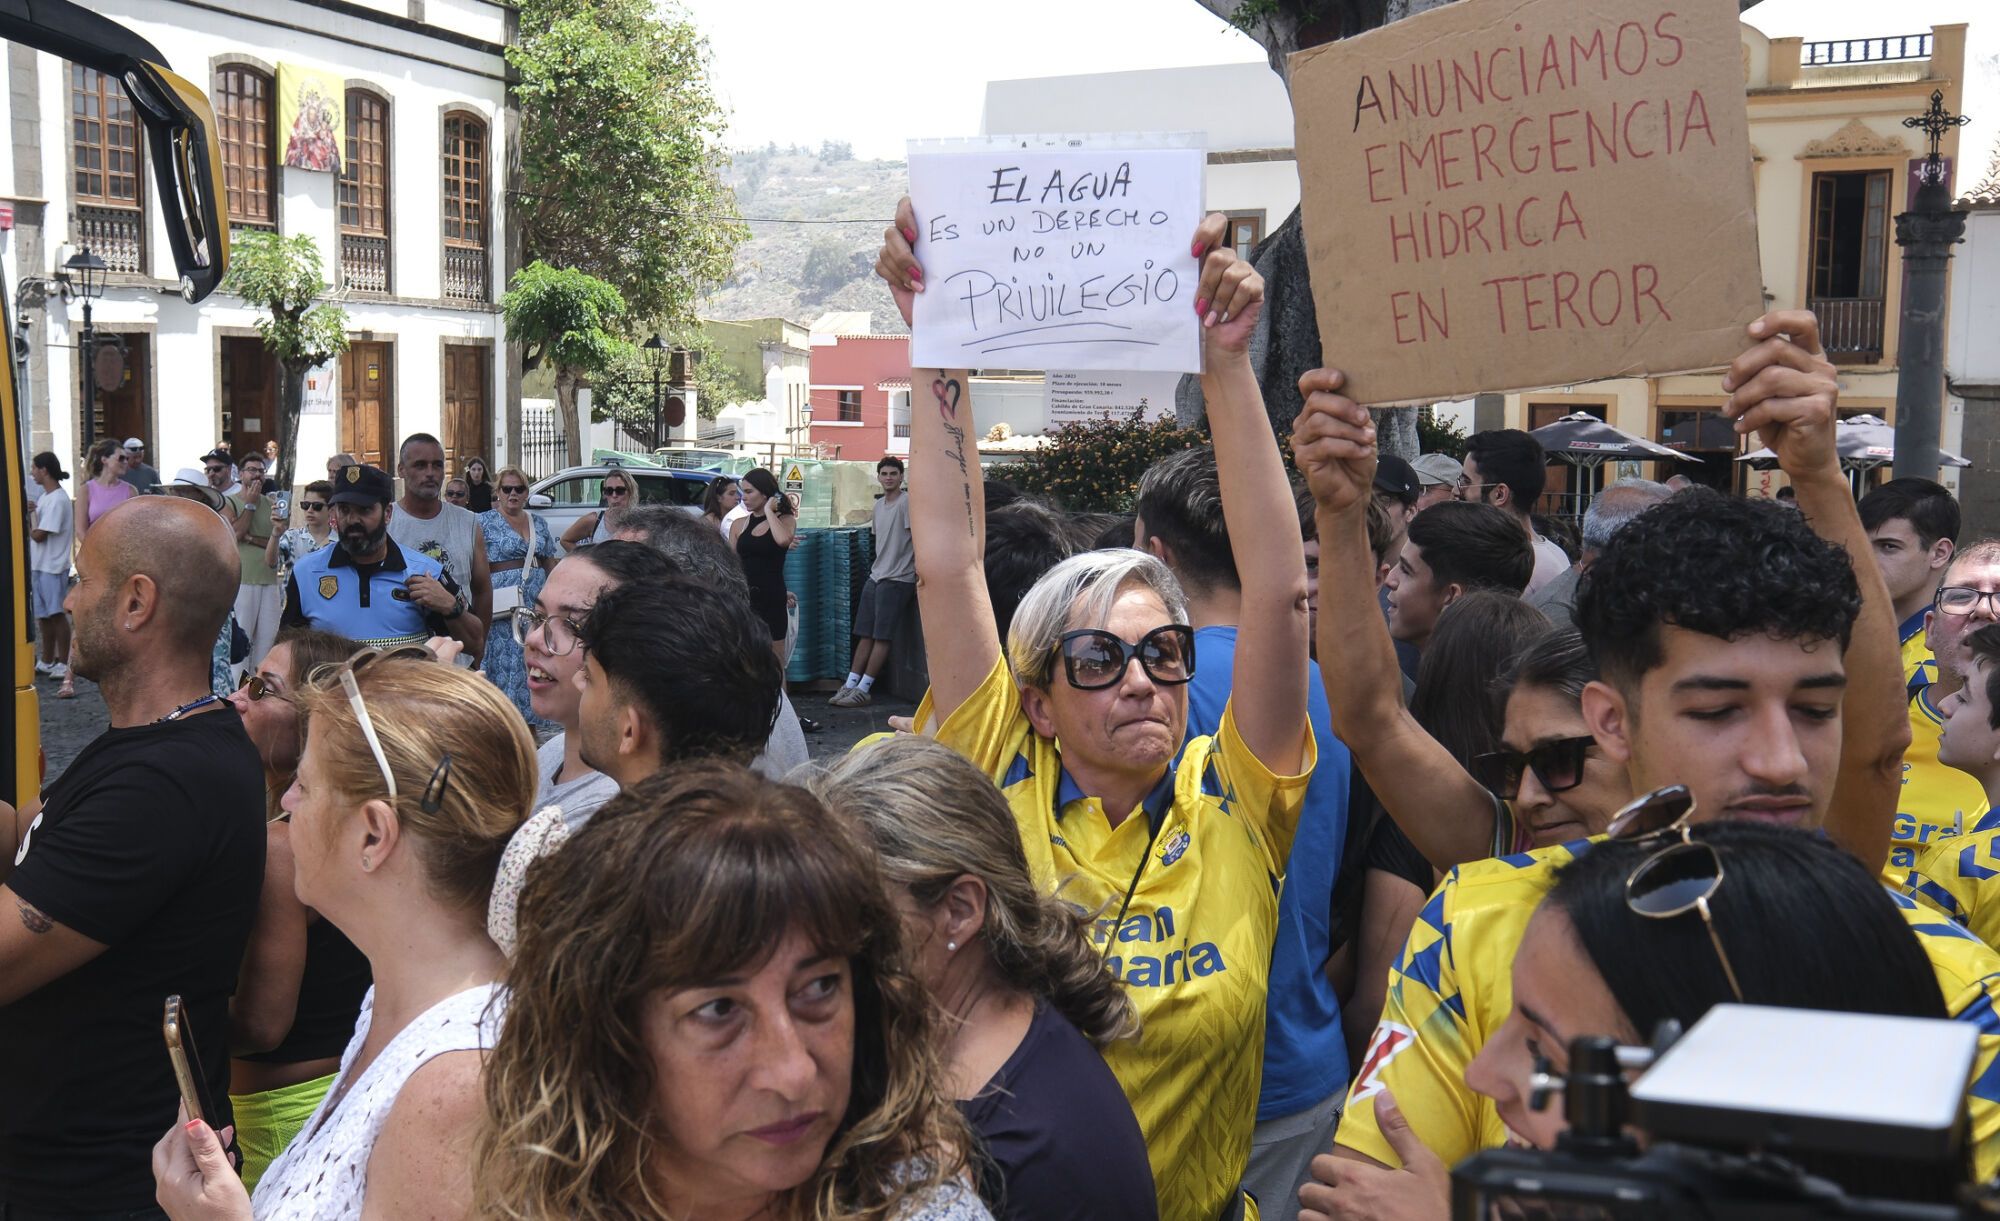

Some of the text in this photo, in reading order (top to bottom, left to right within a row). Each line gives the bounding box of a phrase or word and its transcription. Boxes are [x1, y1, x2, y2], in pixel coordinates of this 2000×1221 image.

[1364, 90, 1717, 203] EMERGENCIA
[987, 162, 1132, 203] EL AGUA
[983, 215, 1016, 235] UN
[1032, 209, 1169, 233] DERECHO
[1389, 190, 1587, 263] HÍDRICA
[1013, 242, 1106, 264] NO UN
[1391, 264, 1672, 344] EN TEROR
[1891, 812, 1958, 845] Gra
[1087, 905, 1175, 945] ran
[1104, 937, 1227, 988] naria
